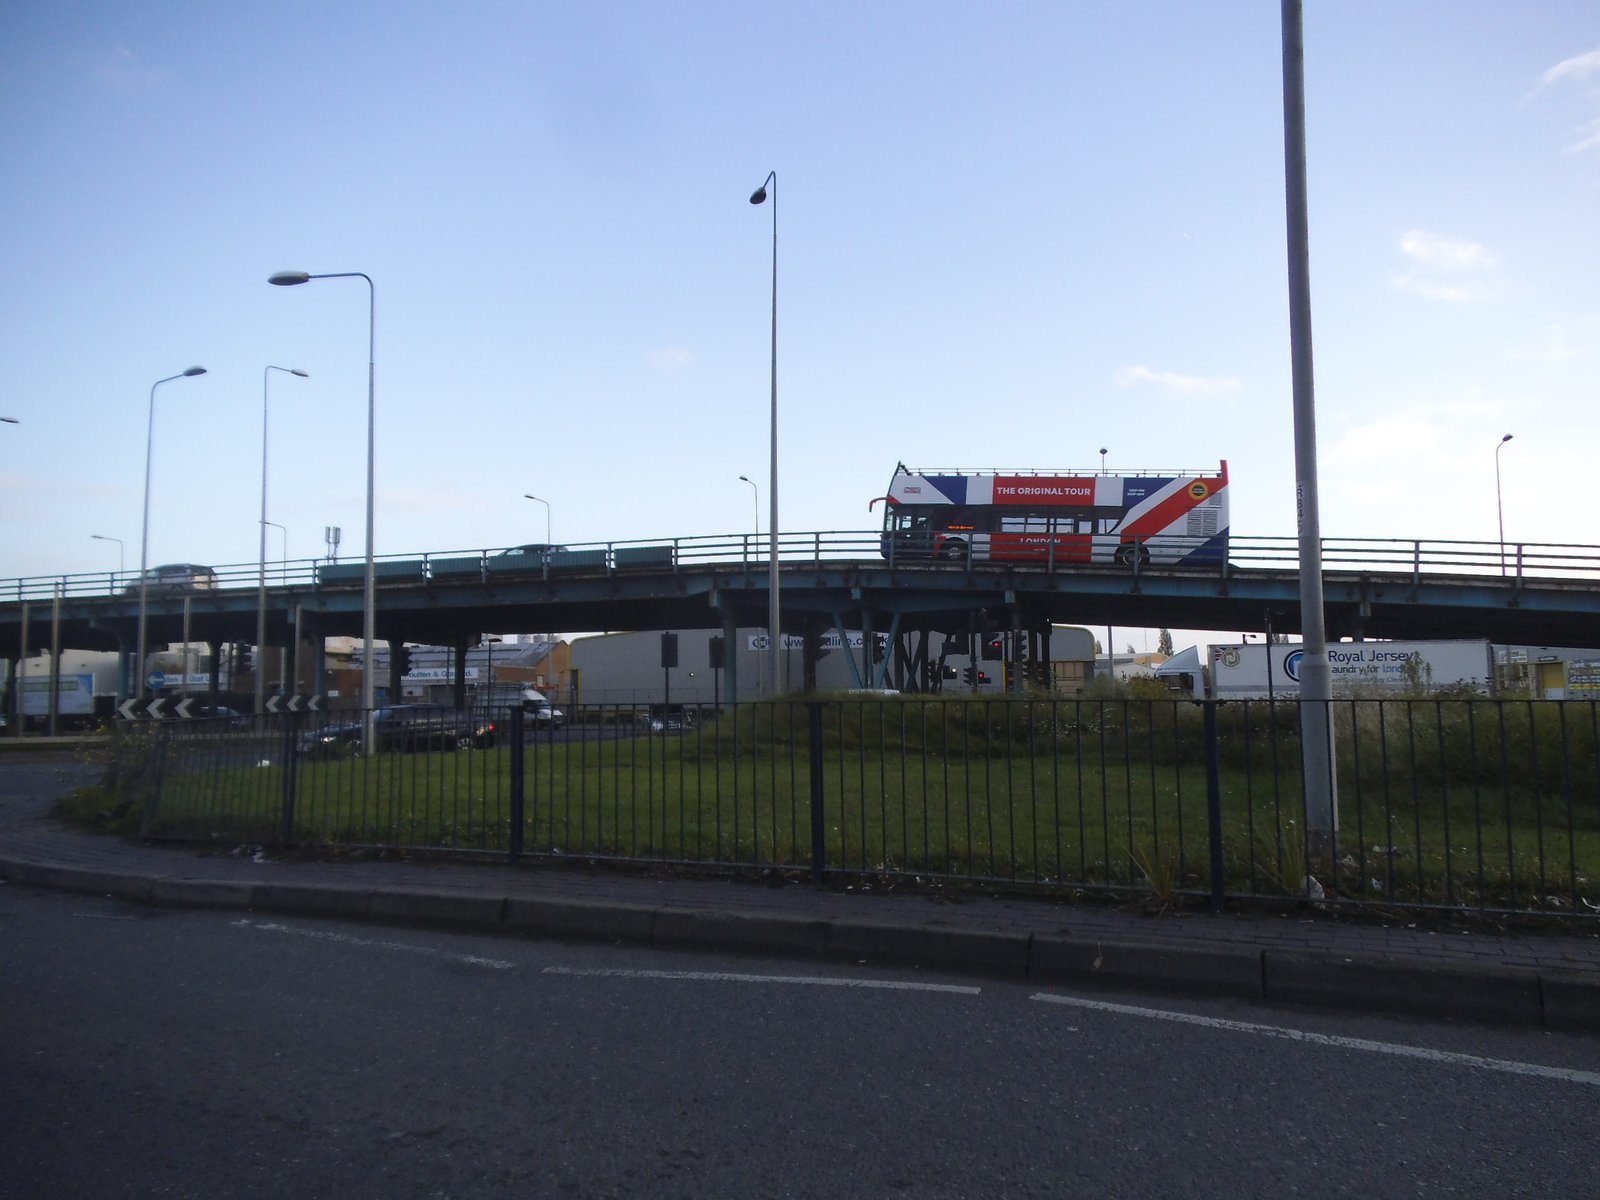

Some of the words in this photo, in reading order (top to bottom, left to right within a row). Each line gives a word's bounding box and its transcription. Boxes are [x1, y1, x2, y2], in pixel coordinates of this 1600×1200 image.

[997, 487, 1015, 495] THE
[1017, 487, 1063, 496] ORIGINAL
[1063, 487, 1091, 496] TOUR
[1328, 650, 1365, 665] Royal
[1368, 650, 1414, 663] Jersey
